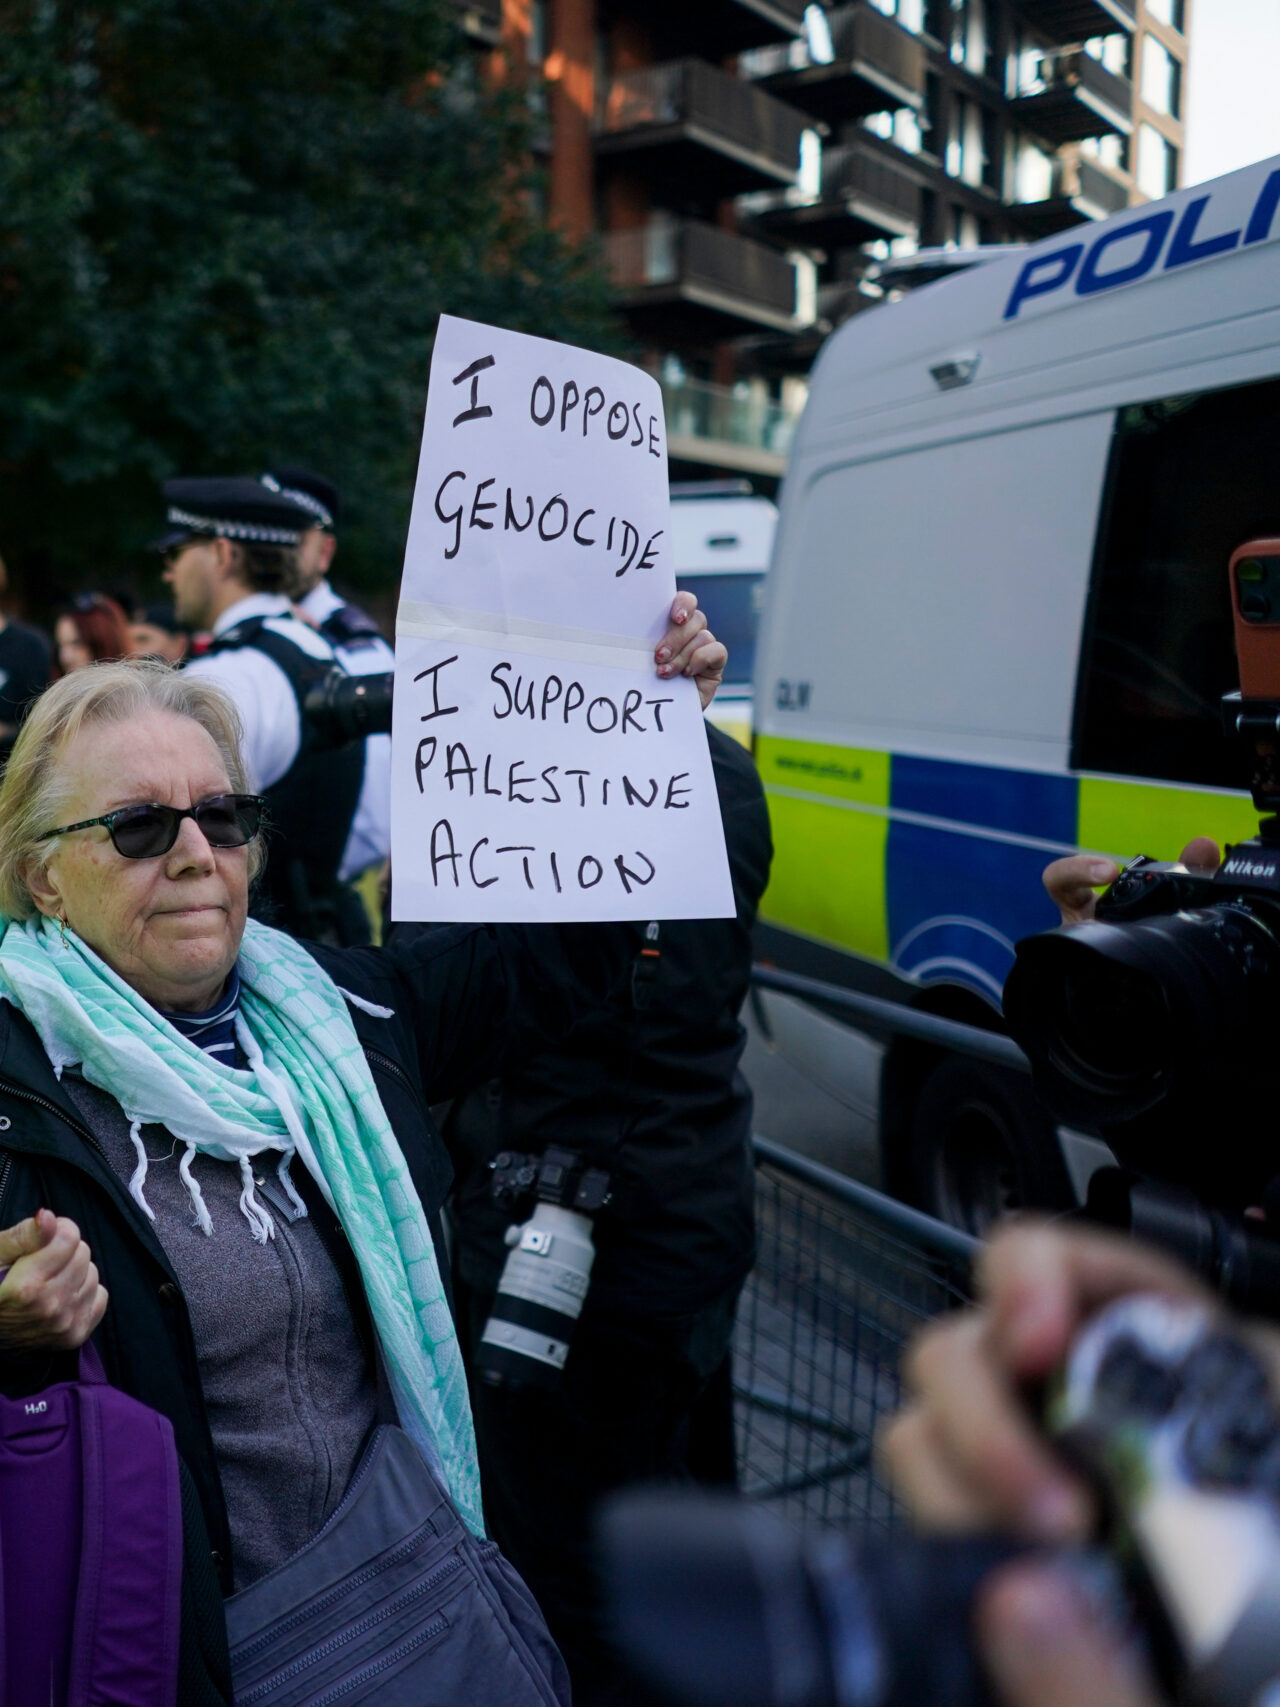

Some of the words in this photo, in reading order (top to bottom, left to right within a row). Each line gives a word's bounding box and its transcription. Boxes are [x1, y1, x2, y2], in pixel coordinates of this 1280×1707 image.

[452, 354, 495, 428] I
[530, 375, 661, 458] OPPOSE
[434, 470, 664, 578] GENOCIDE
[413, 655, 459, 722] I
[490, 662, 674, 734] SUPPORT
[414, 736, 691, 810] PALESTINE
[430, 818, 656, 894] ACTION
[1224, 859, 1275, 876] Nikon
